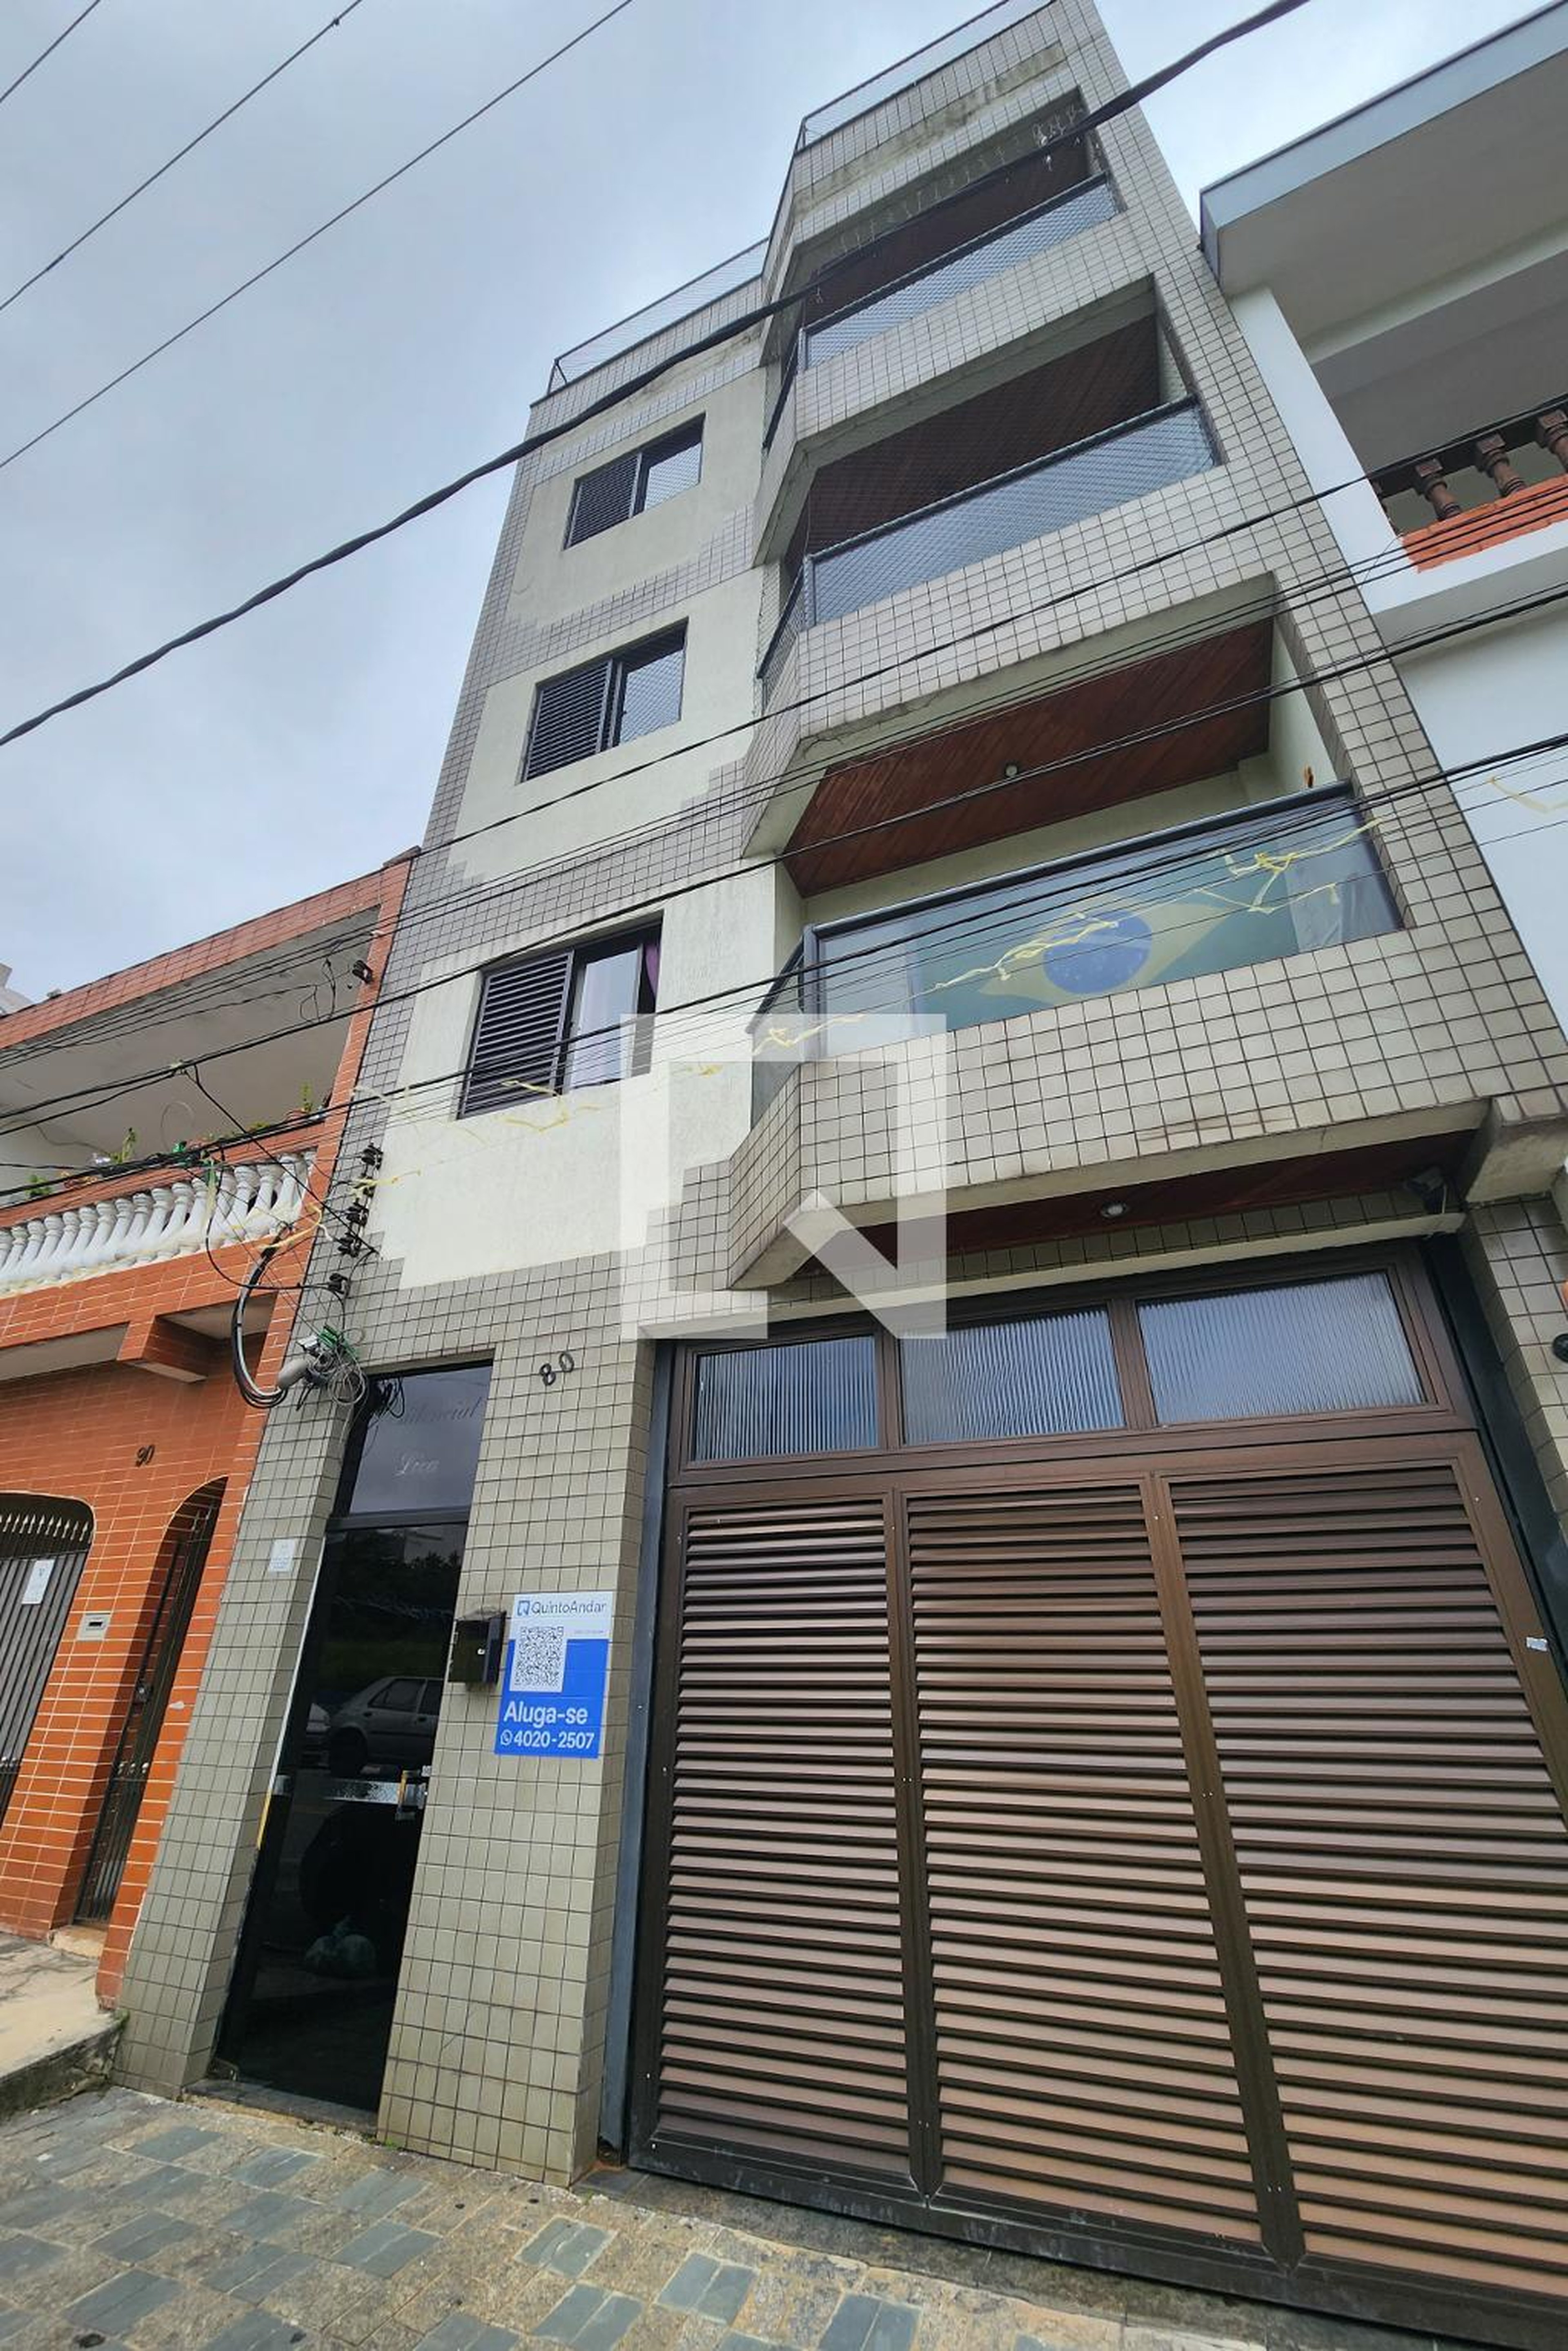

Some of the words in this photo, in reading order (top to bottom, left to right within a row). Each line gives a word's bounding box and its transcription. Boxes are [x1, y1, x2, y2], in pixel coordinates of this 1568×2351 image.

[539, 1351, 575, 1386] 80
[135, 1444, 156, 1468] 90
[531, 1600, 607, 1615] QuintoAndar
[503, 1700, 588, 1729] Aluga-se
[513, 1730, 595, 1749] 4020-2507
